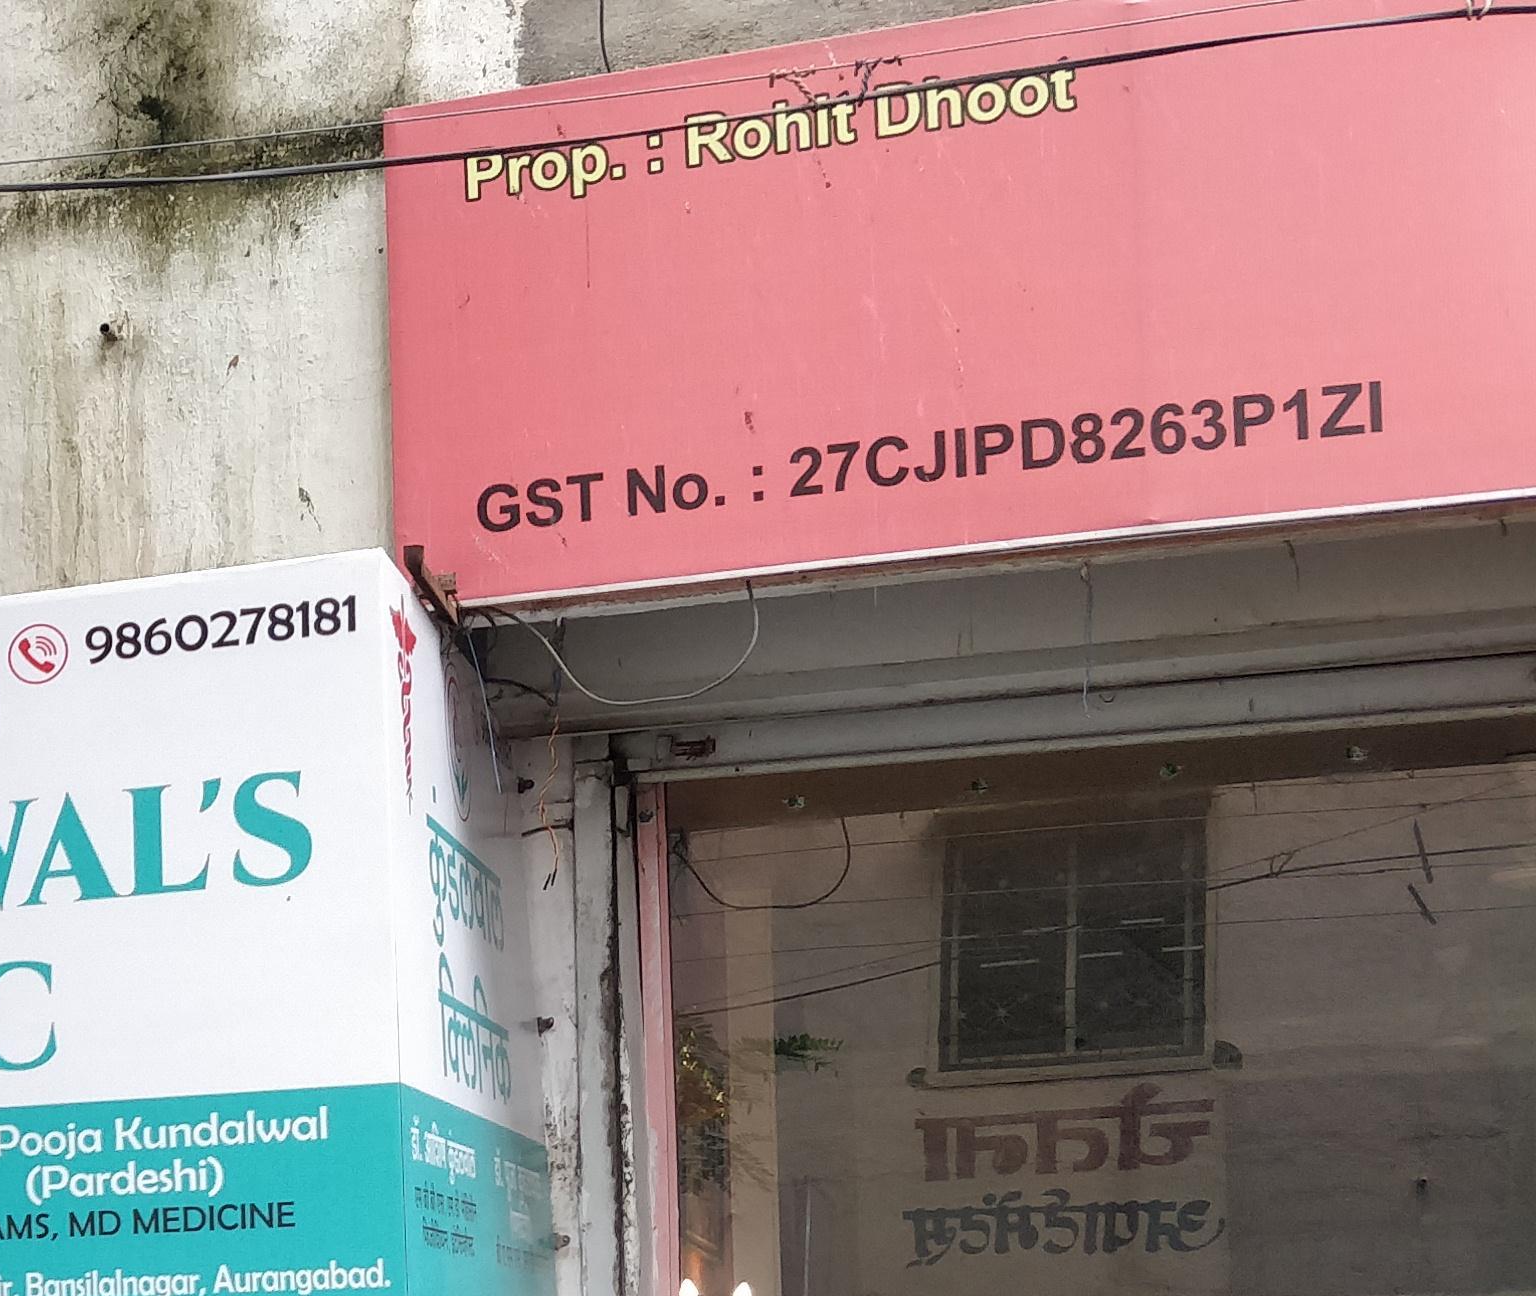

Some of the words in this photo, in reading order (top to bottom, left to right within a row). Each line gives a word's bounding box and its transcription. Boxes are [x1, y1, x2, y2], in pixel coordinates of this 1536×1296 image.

[464, 141, 626, 201] Prop.
[683, 98, 858, 169] Rohit
[874, 67, 1078, 140] Dhoot
[476, 471, 604, 533] GST
[626, 464, 726, 518] No.
[752, 465, 765, 503] :
[789, 380, 1384, 498] 27CJIPD8263P1ZI
[84, 594, 357, 665] 9860278181
[114, 1105, 329, 1151] Kundalwal
[25, 1155, 225, 1207] (Pardeshi)
[68, 1210, 122, 1238] MD
[132, 1200, 296, 1235] MEDICINE
[212, 1257, 392, 1296] Aurangabad.
